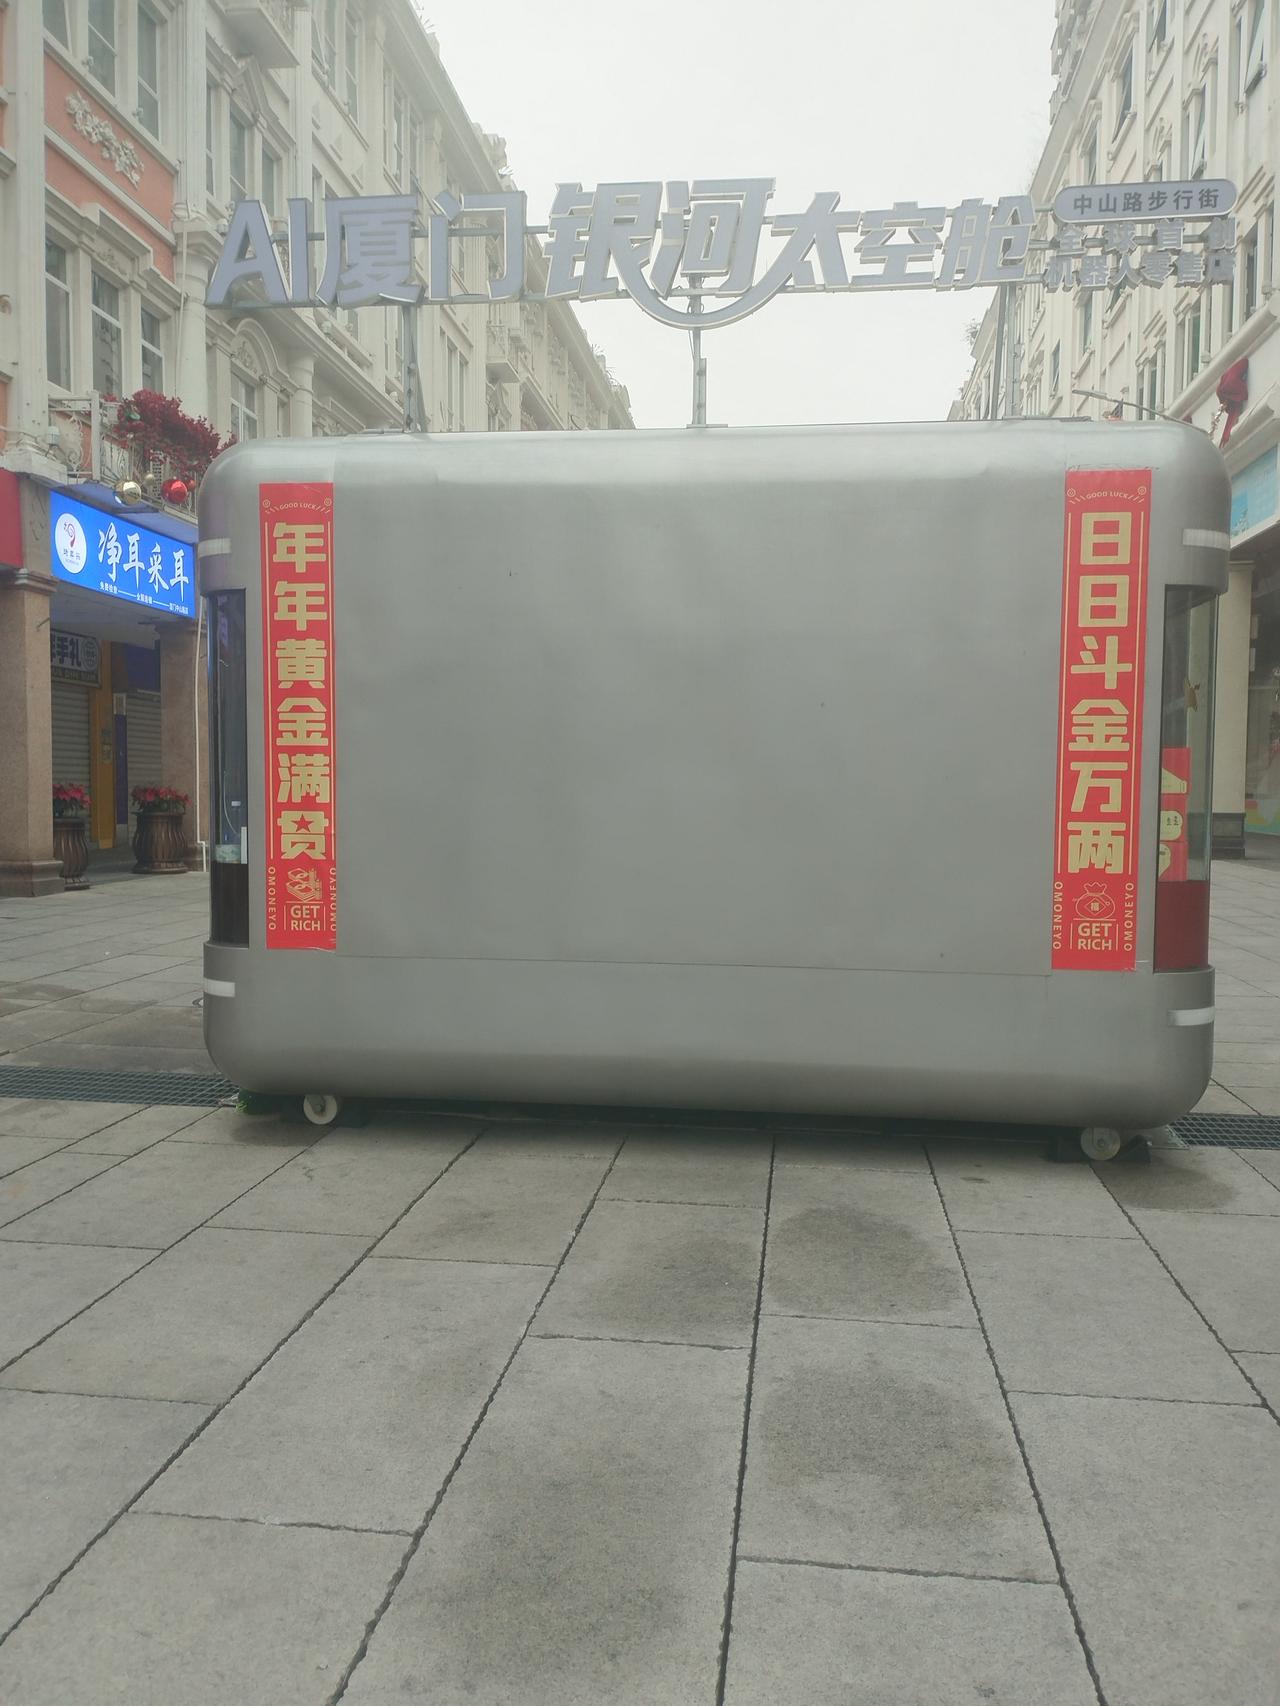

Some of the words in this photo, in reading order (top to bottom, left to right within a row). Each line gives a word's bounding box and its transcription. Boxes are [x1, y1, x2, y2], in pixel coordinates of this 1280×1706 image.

[1073, 188, 1219, 215] 中山路步行街
[1056, 218, 1236, 255] 全球首创
[1044, 248, 1236, 292] 机器人零售店
[280, 502, 298, 510] GOOD
[300, 502, 316, 510] LUCK
[1086, 491, 1107, 499] GOOD
[1110, 491, 1128, 499] LUCK
[98, 521, 189, 602] 净耳采耳
[273, 522, 330, 860] 年年黄金满贯
[1067, 511, 1132, 874] 日日斗金万两
[268, 867, 276, 930] OMONEYO
[290, 905, 320, 918] GET
[1053, 881, 1063, 949] OMONEYO
[1124, 882, 1134, 951] OMONEYO
[290, 920, 320, 931] RICH
[1078, 922, 1112, 937] GET
[1078, 938, 1112, 950] RICH
